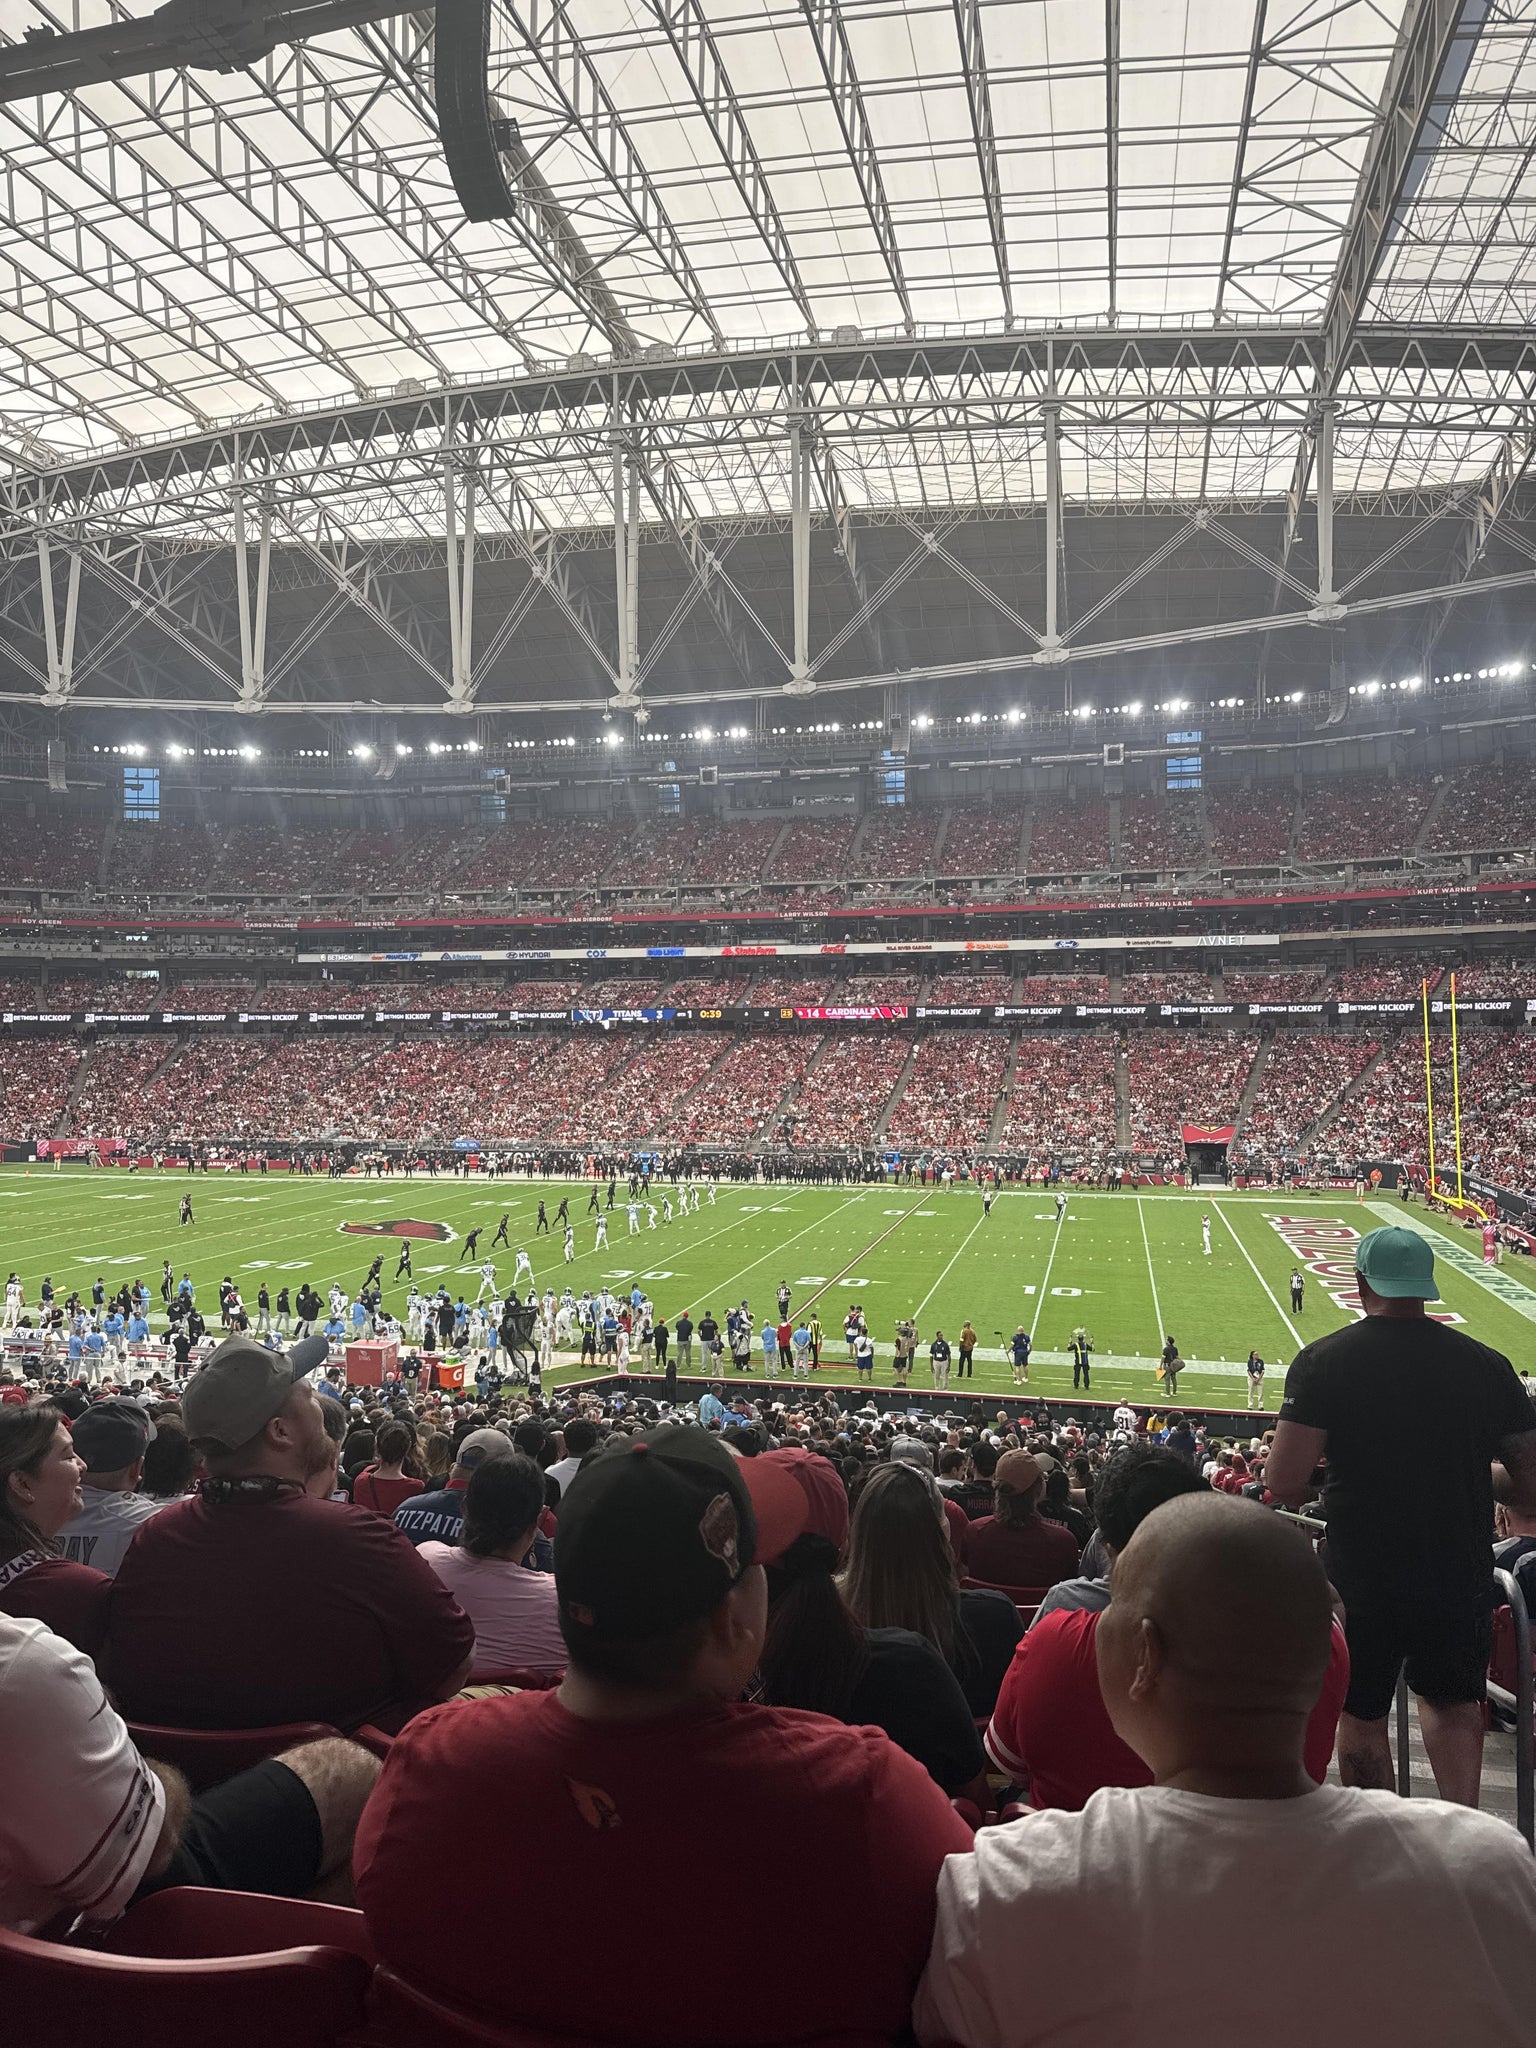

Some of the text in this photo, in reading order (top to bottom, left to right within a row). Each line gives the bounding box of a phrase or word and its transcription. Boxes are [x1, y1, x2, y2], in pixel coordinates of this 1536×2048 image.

[1441, 886, 1477, 894] WARNER
[1197, 935, 1246, 946] AVNET
[586, 950, 607, 958] COX
[1288, 1005, 1323, 1013] KICKOFF
[1378, 1004, 1415, 1012] KICKOFF
[1474, 1002, 1512, 1010] KICKOFF
[612, 1010, 663, 1019] TITANS 3
[700, 1010, 722, 1019] 0:39
[806, 1008, 876, 1018] 14 CARDINALS
[239, 1260, 314, 1270] 50
[600, 1270, 674, 1280] 30
[794, 1276, 870, 1287] 20
[1022, 1285, 1082, 1296] 10
[388, 1324, 400, 1333] 69
[453, 1368, 463, 1382] G
